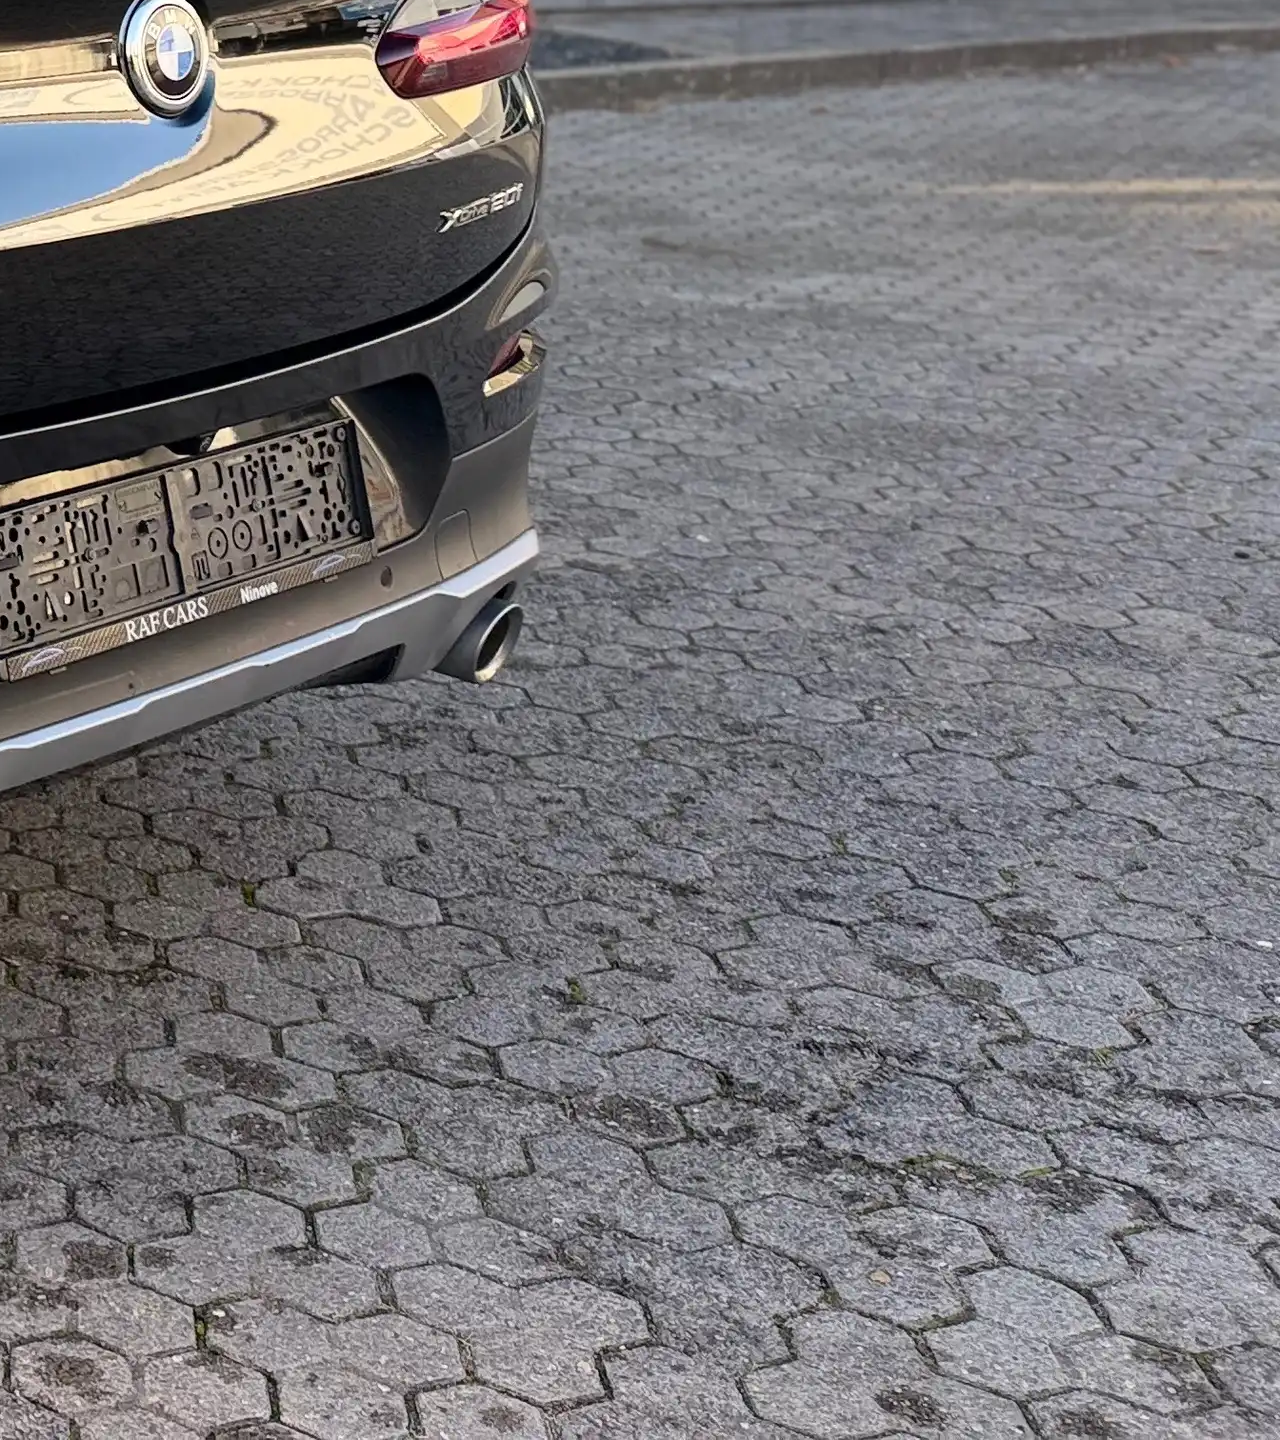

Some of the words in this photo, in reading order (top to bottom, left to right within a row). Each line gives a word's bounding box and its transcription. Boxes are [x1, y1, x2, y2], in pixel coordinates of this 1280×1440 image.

[146, 8, 197, 41] BMW
[123, 611, 161, 643] RAF
[162, 596, 209, 629] CARS
[240, 580, 279, 605] Ninove
